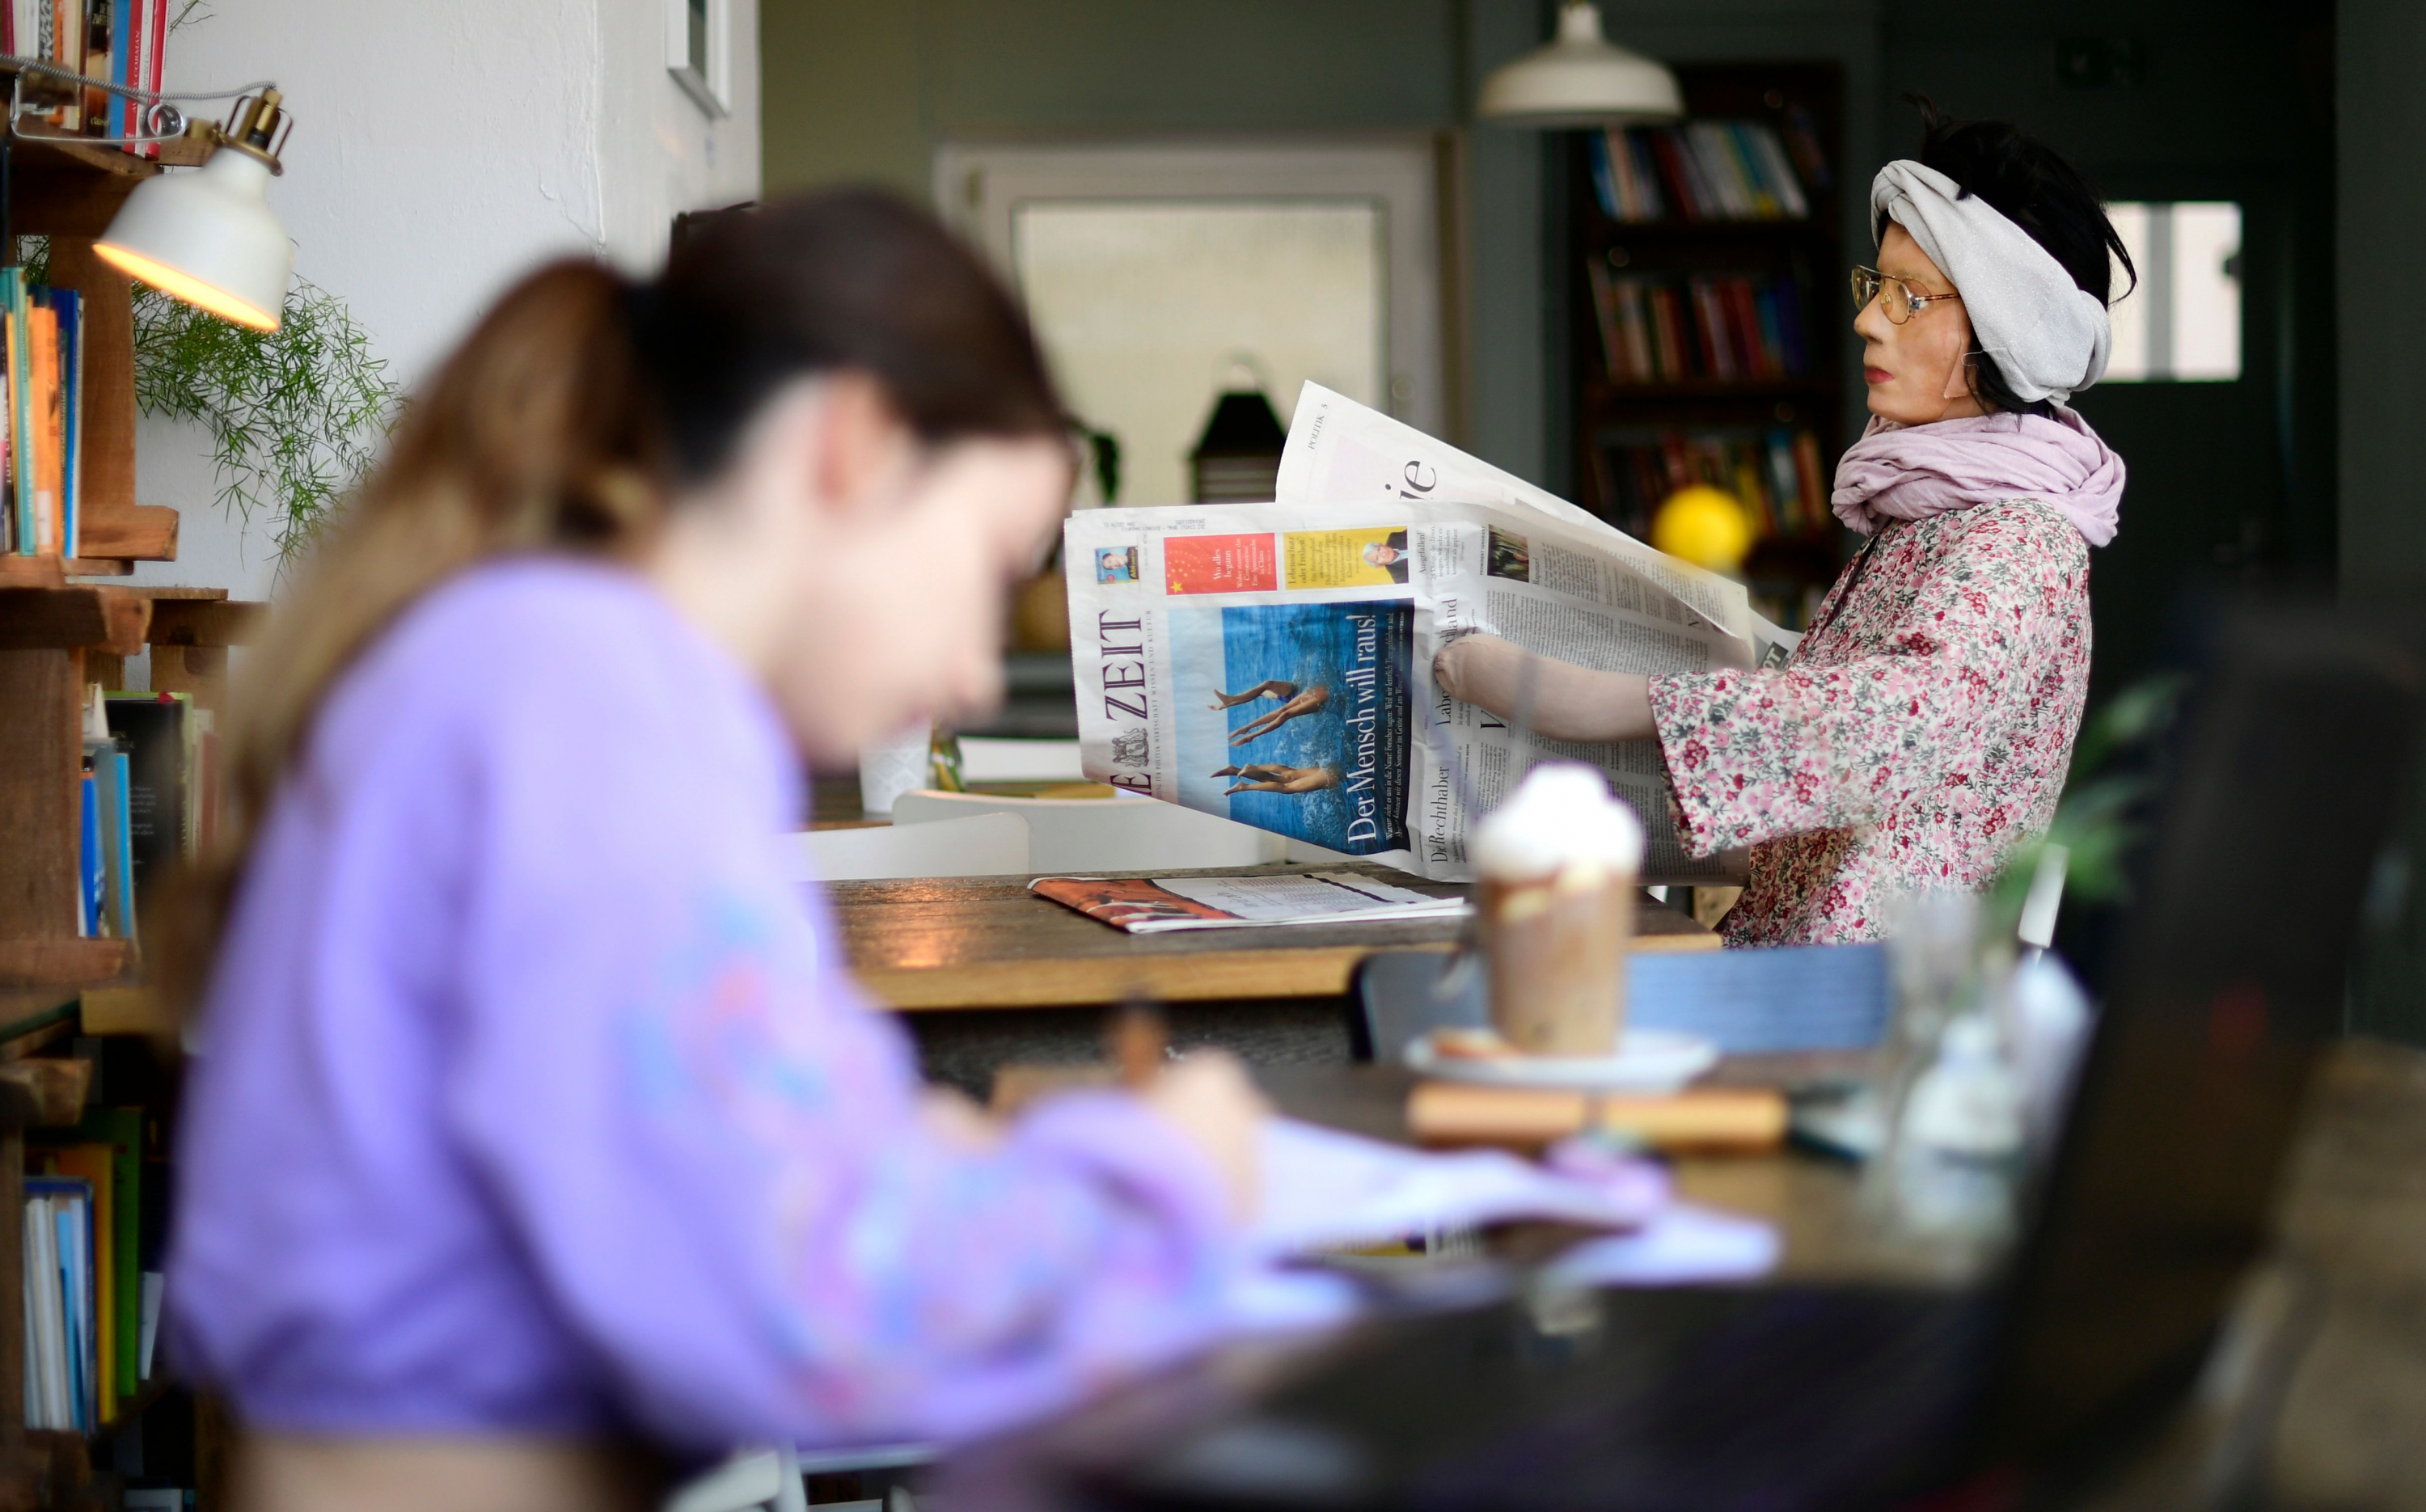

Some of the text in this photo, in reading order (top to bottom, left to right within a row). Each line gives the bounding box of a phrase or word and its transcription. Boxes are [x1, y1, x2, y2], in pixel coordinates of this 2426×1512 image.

[1308, 414, 1324, 450] POLITIK
[1224, 551, 1233, 577] begann
[1287, 537, 1295, 584] Lebensschutz
[1417, 533, 1427, 575] Ausgefallen!
[1214, 567, 1221, 580] Wo
[1532, 557, 1541, 585] Rapunzel
[1099, 609, 1147, 721] ZEIT
[1762, 647, 1781, 669] OT
[1387, 711, 1395, 727] sagen:
[1435, 688, 1451, 725] Labo
[1346, 615, 1377, 844] Der Mensch will raus!
[1384, 728, 1393, 750] Forscher
[1395, 717, 1404, 734] Grüne
[1428, 767, 1450, 863] Die Rechthaber
